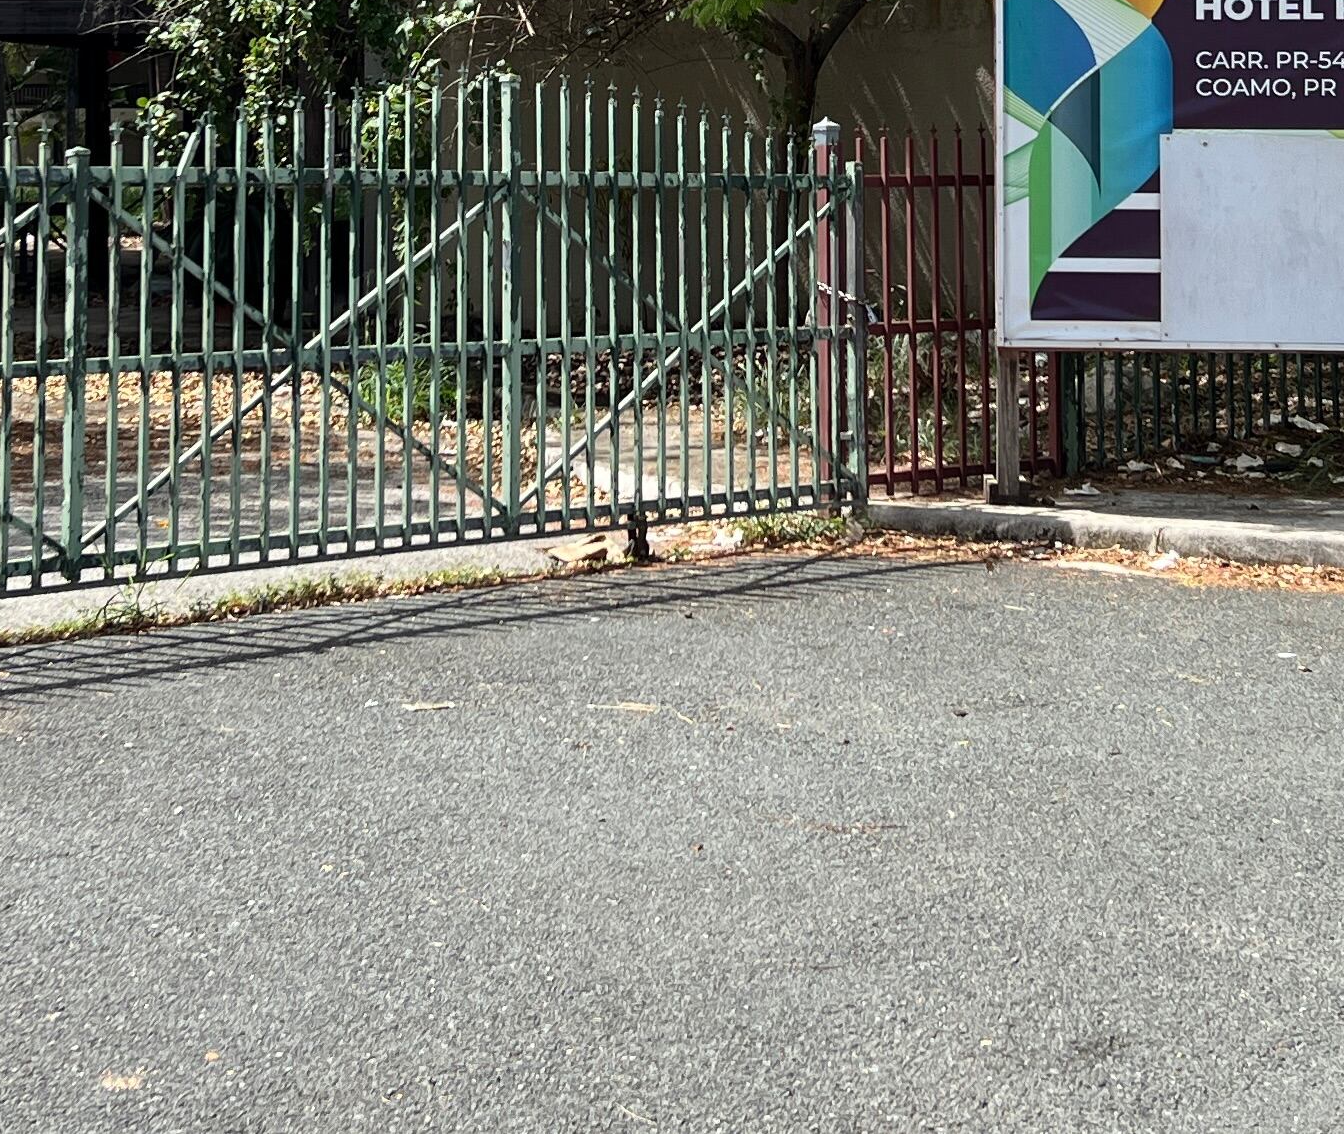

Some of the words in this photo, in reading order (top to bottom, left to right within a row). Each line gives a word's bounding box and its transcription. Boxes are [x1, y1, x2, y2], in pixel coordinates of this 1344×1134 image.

[1195, 51, 1269, 70] CARR.
[1195, 77, 1298, 100] COAMO,
[1304, 78, 1338, 98] PR
